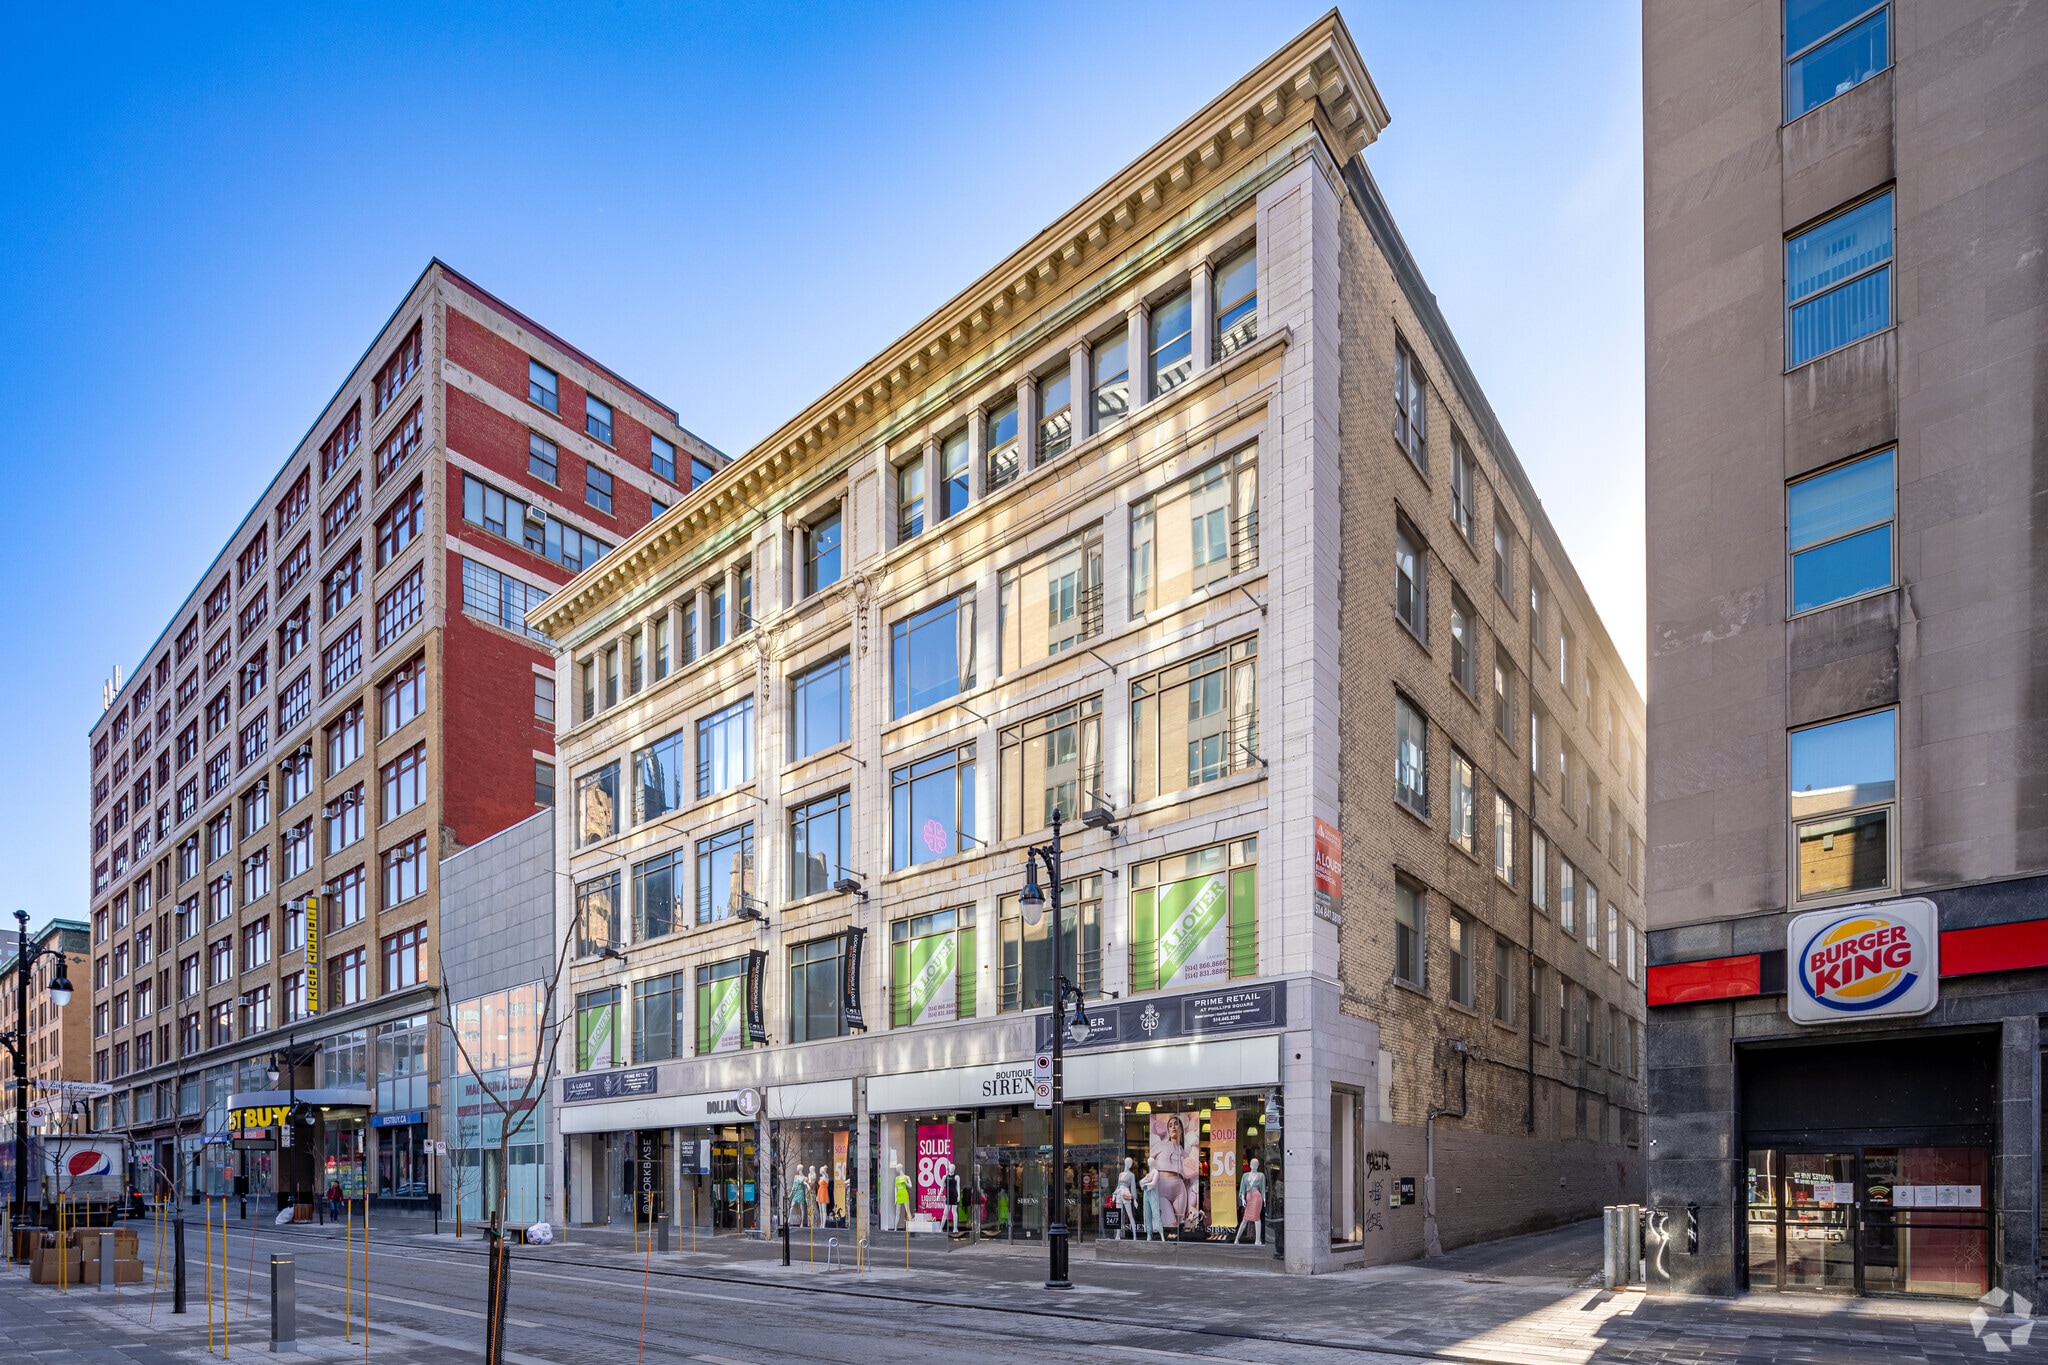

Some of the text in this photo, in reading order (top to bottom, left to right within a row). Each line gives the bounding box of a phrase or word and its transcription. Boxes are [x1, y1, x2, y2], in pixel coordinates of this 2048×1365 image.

[1322, 854, 1341, 877] LOUER
[1160, 939, 1176, 957] À
[1172, 880, 1226, 943] LOUER
[1810, 926, 1907, 973] BURGER
[920, 938, 955, 986] LOUER
[1816, 942, 1912, 997] KING
[716, 982, 740, 1020] LOUER
[1194, 993, 1260, 1007] PRIME RETAIL
[594, 1009, 611, 1042] LOUER
[502, 1077, 507, 1091] À
[996, 1069, 1032, 1080] BOUTIQUE
[67, 1084, 107, 1092] Councillors
[982, 1077, 1035, 1097] SIREN
[246, 1106, 291, 1128] BUY
[383, 1115, 406, 1125] BESTBUY.CA
[1212, 1128, 1236, 1140] SOLDE
[920, 1139, 951, 1155] SOLDE
[918, 1157, 951, 1187] 80
